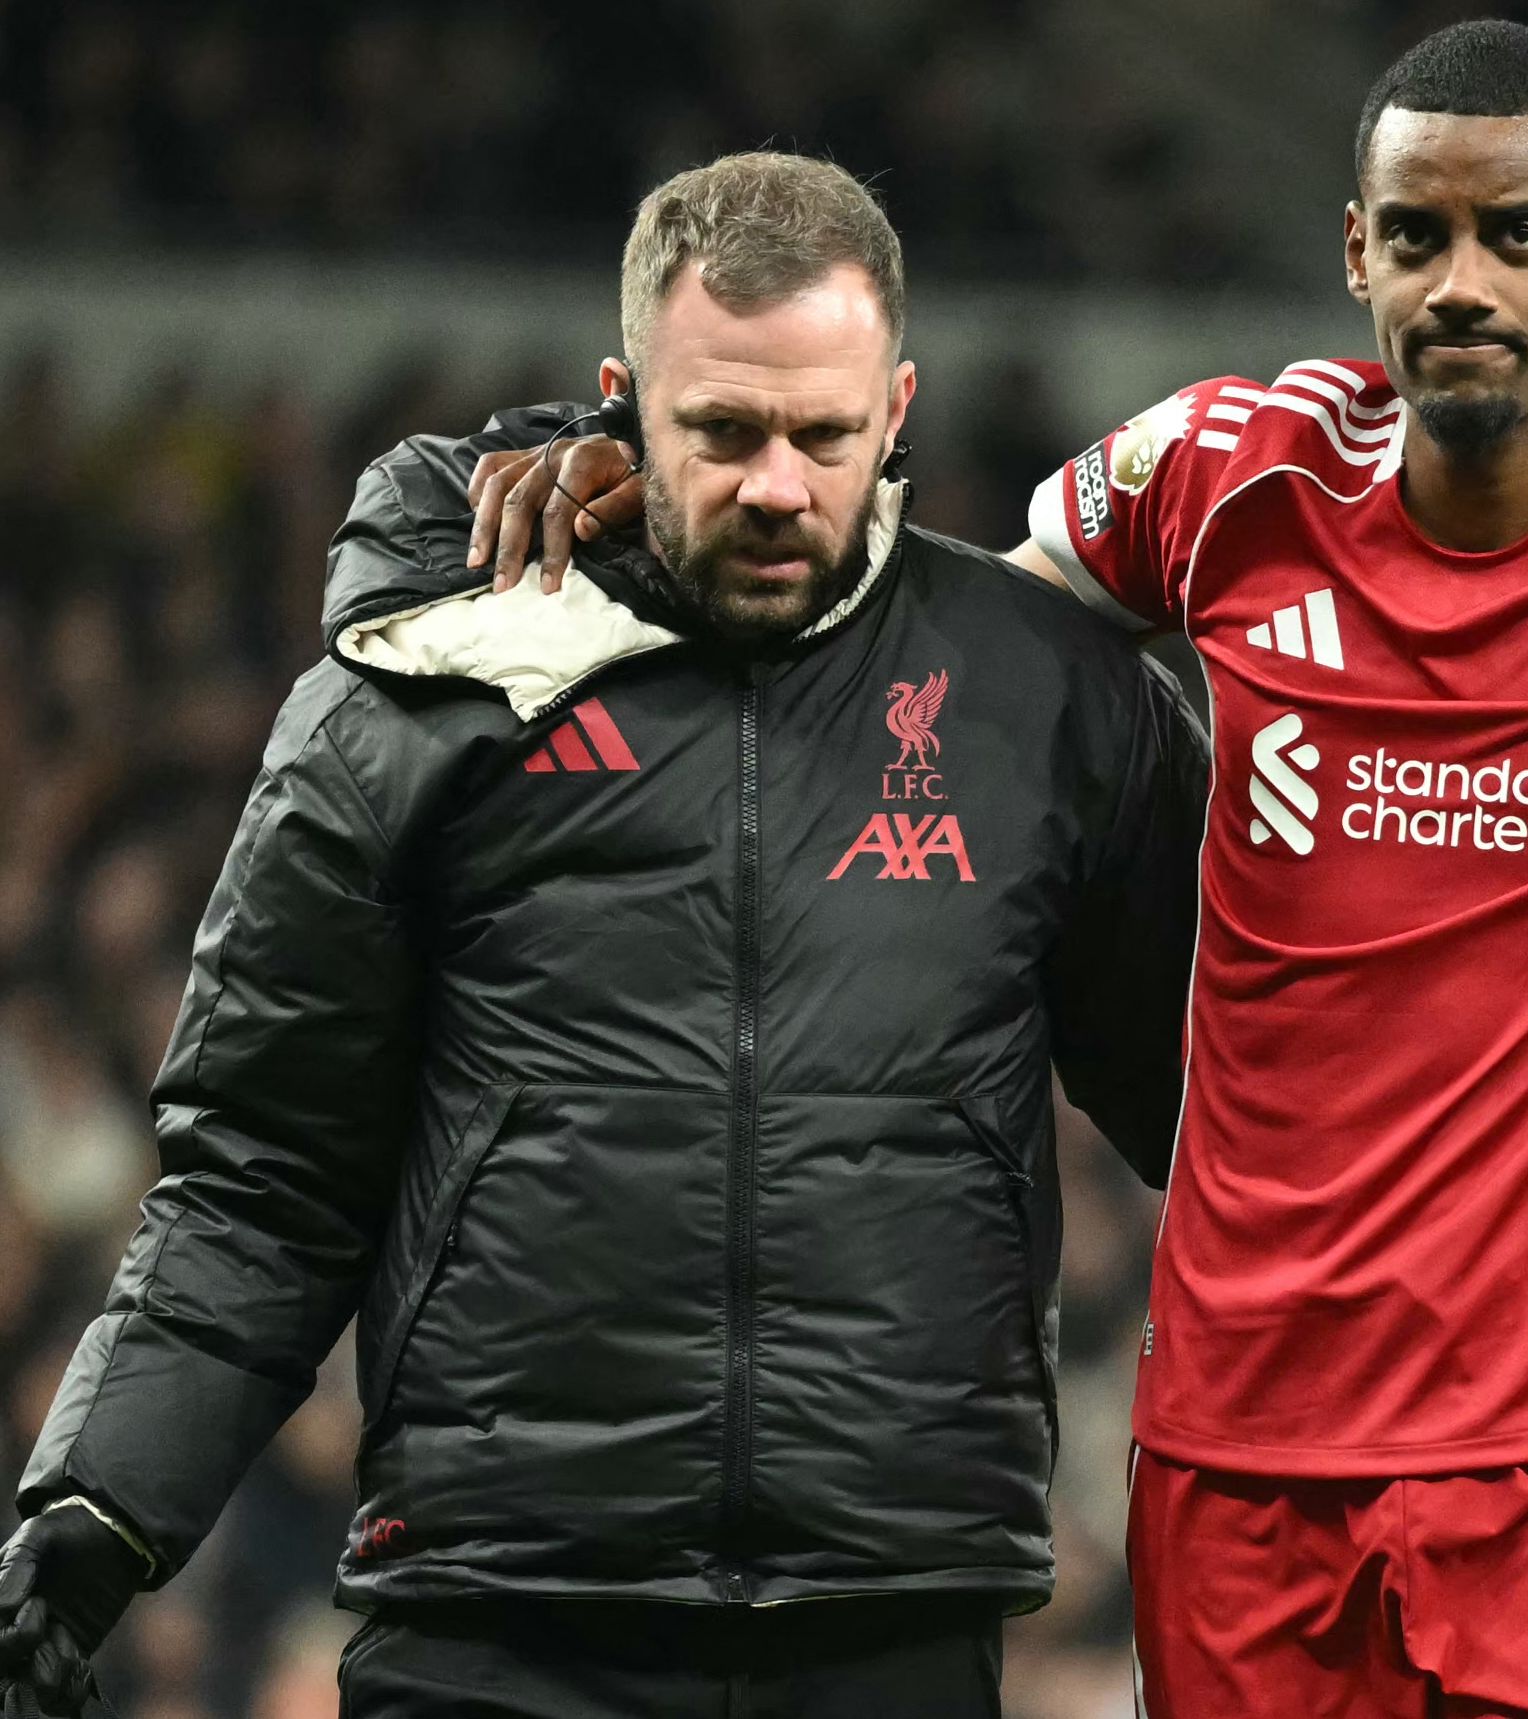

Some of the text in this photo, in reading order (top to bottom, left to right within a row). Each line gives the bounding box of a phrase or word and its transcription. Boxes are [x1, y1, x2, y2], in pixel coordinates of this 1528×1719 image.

[1074, 458, 1099, 540] racism
[1087, 450, 1108, 521] room
[825, 813, 976, 882] AXA
